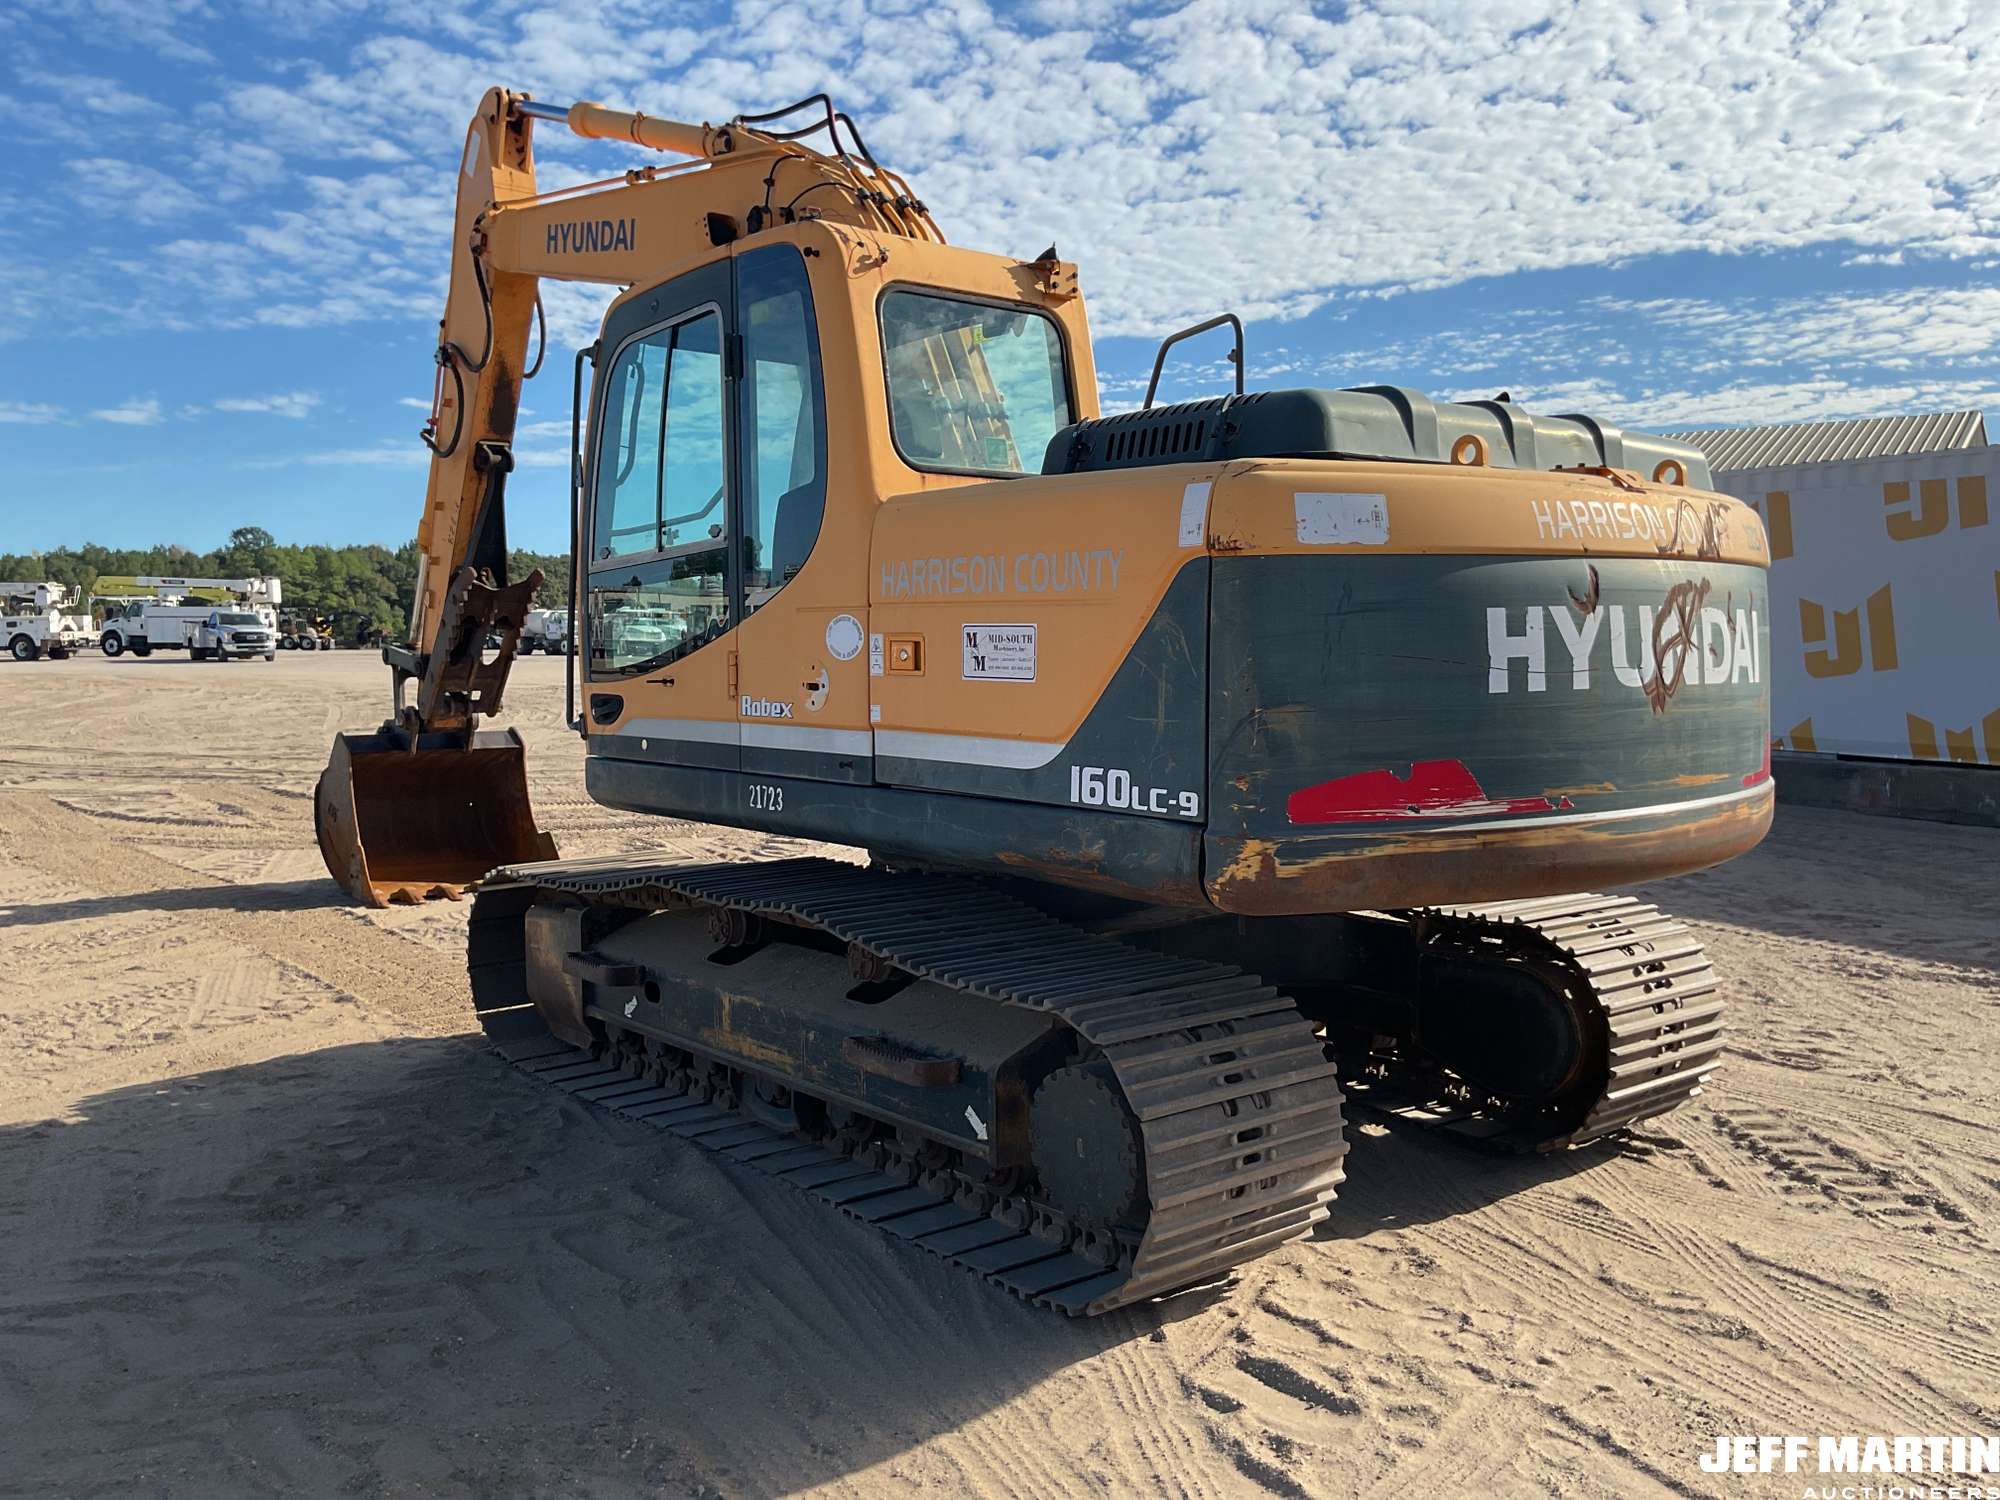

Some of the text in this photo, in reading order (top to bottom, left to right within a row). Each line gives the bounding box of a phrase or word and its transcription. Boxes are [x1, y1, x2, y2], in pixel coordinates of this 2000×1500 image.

[546, 218, 636, 254] HYUNDAI
[1531, 500, 1667, 541] HARRISON
[880, 549, 1125, 598] HARRISON COUNTY
[988, 634, 1033, 644] MID-SOUTH
[1486, 605, 1760, 694] HYUNDAI
[741, 695, 793, 719] Robex
[749, 785, 783, 811] 21723
[1070, 765, 1200, 817] 160LC-9
